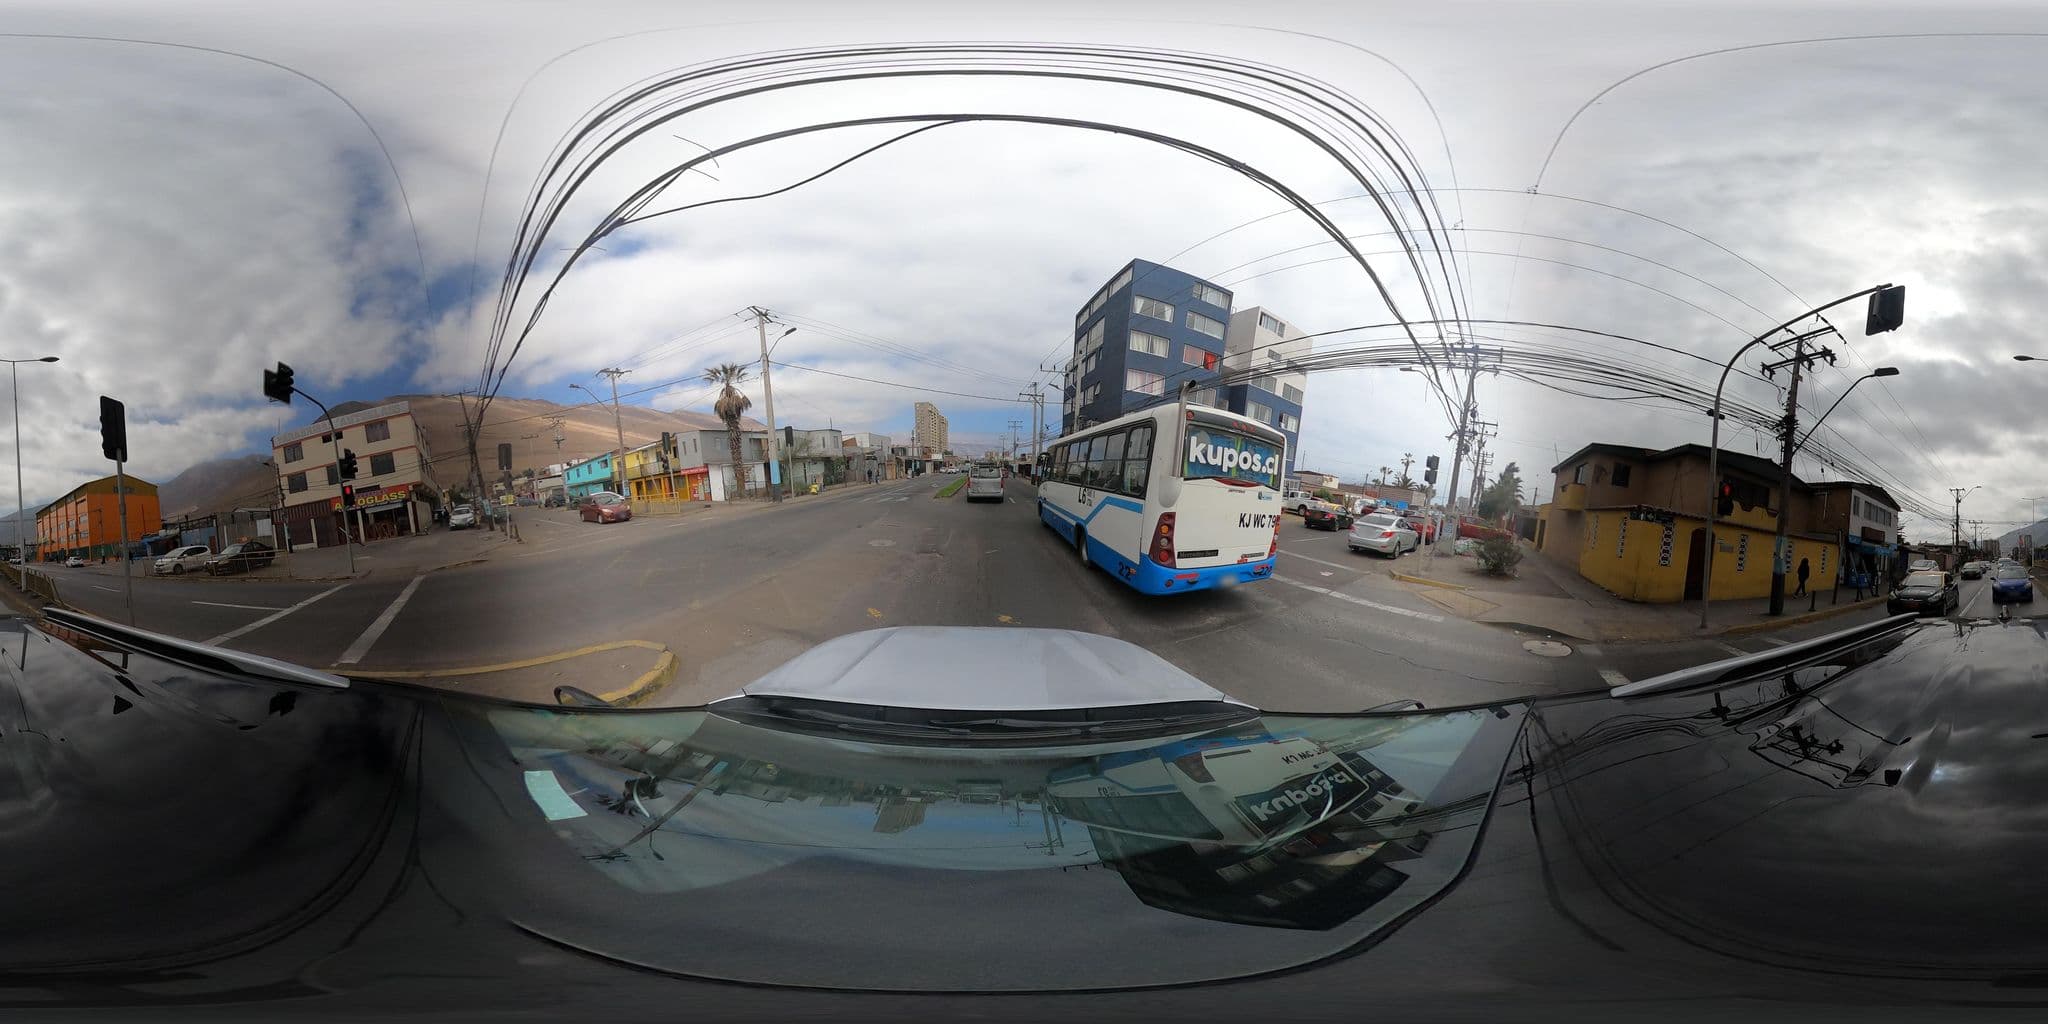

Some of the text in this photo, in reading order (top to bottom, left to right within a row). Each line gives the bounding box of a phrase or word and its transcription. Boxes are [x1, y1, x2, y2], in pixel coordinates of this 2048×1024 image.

[1189, 436, 1279, 475] kupos.cl
[335, 490, 407, 511] AOGLASS
[1238, 513, 1252, 528] KJ
[1253, 513, 1266, 529] WC
